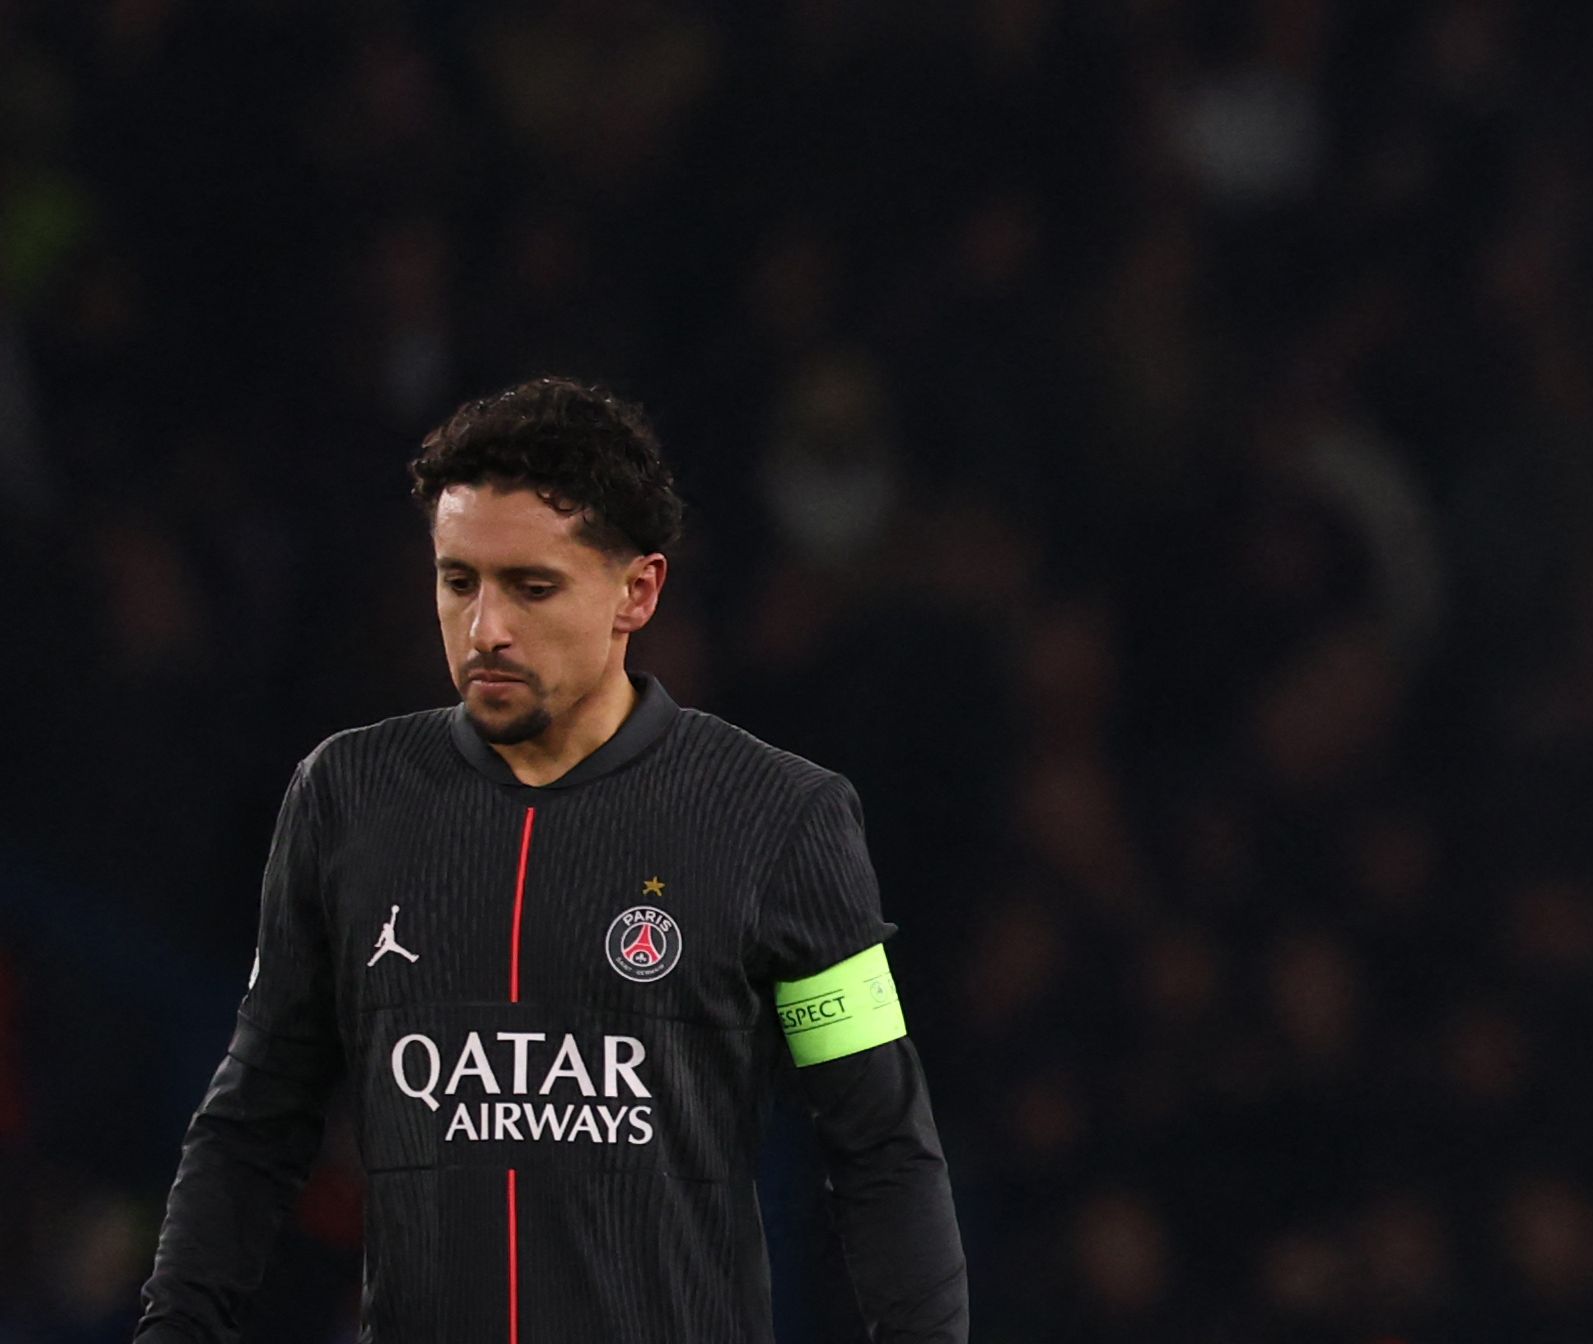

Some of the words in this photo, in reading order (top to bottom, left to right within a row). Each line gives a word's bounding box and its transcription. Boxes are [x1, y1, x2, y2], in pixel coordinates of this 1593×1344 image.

[623, 910, 673, 933] PARIS
[778, 996, 845, 1029] ESPECT
[391, 1031, 652, 1112] QATAR
[445, 1102, 653, 1146] AIRWAYS
